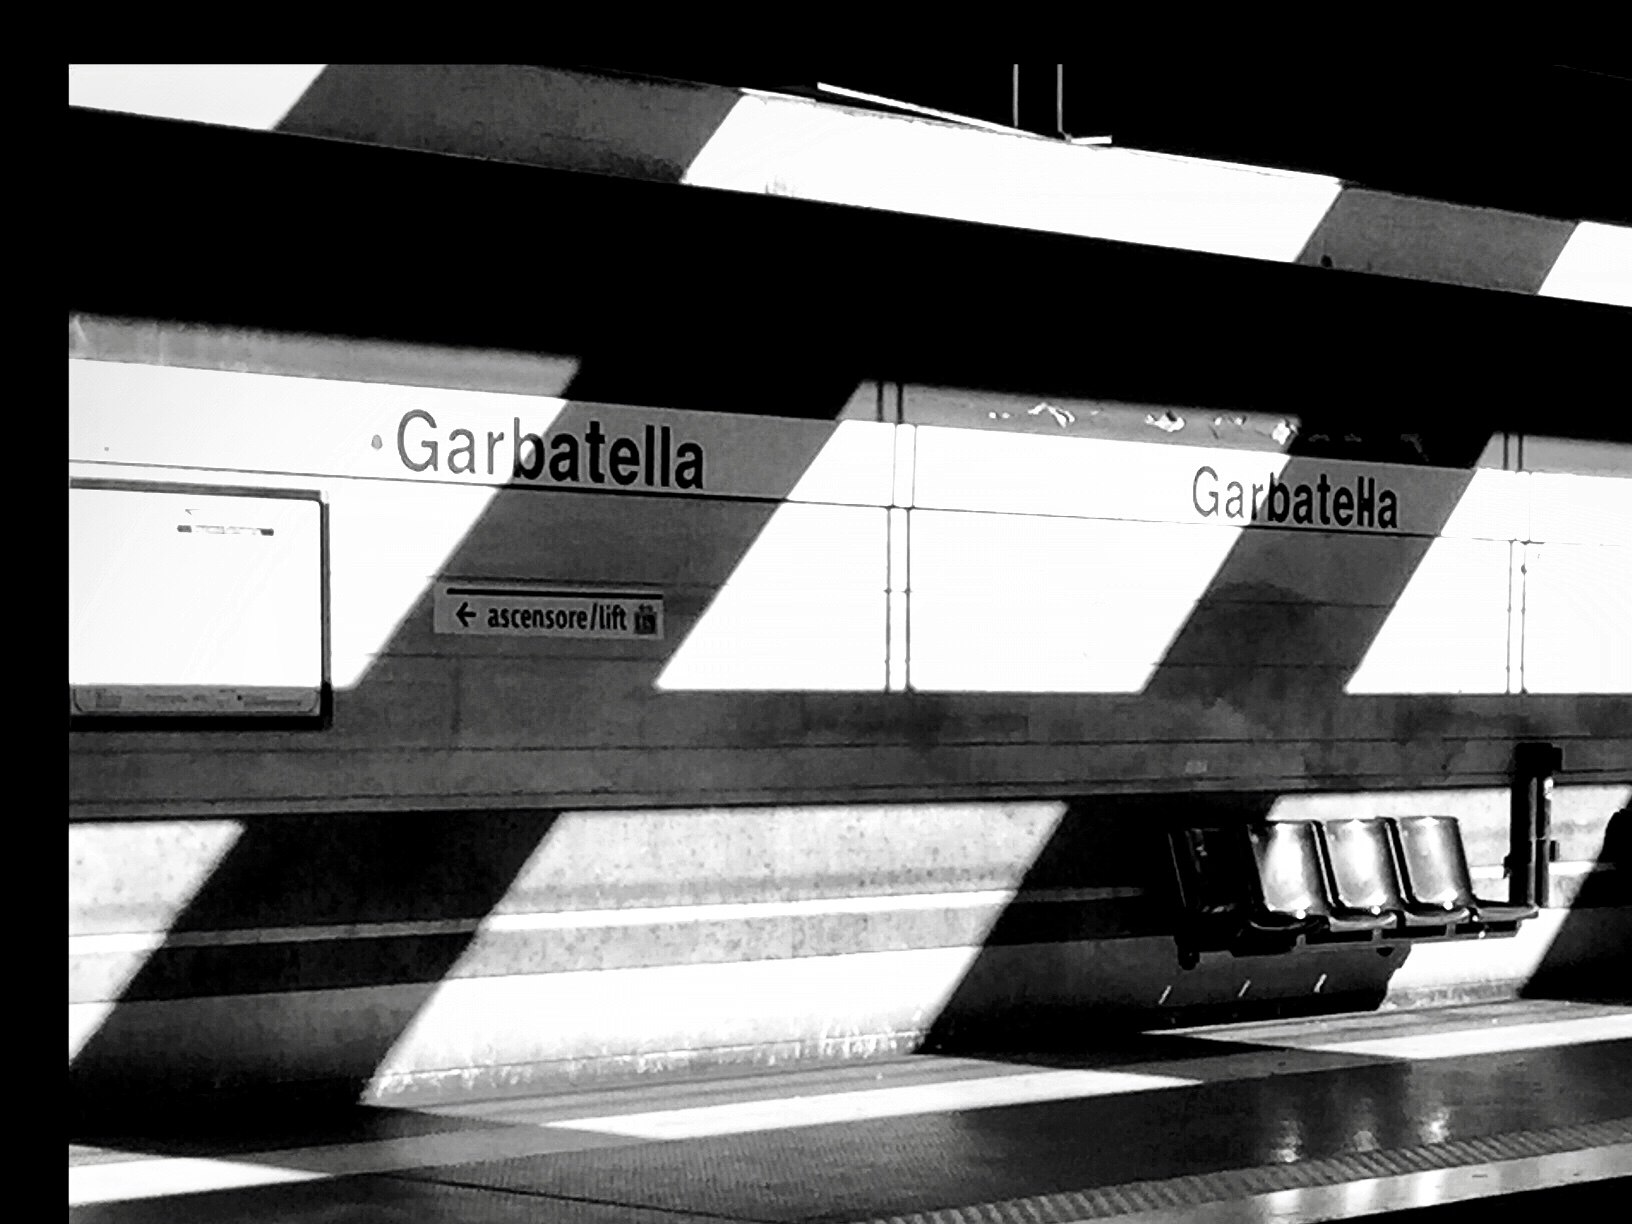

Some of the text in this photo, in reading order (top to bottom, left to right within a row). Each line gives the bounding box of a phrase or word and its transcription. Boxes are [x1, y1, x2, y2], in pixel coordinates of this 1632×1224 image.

[397, 409, 704, 490] Garbatella
[1192, 465, 1398, 529] Garbatella
[487, 603, 628, 631] ascensore/lift
